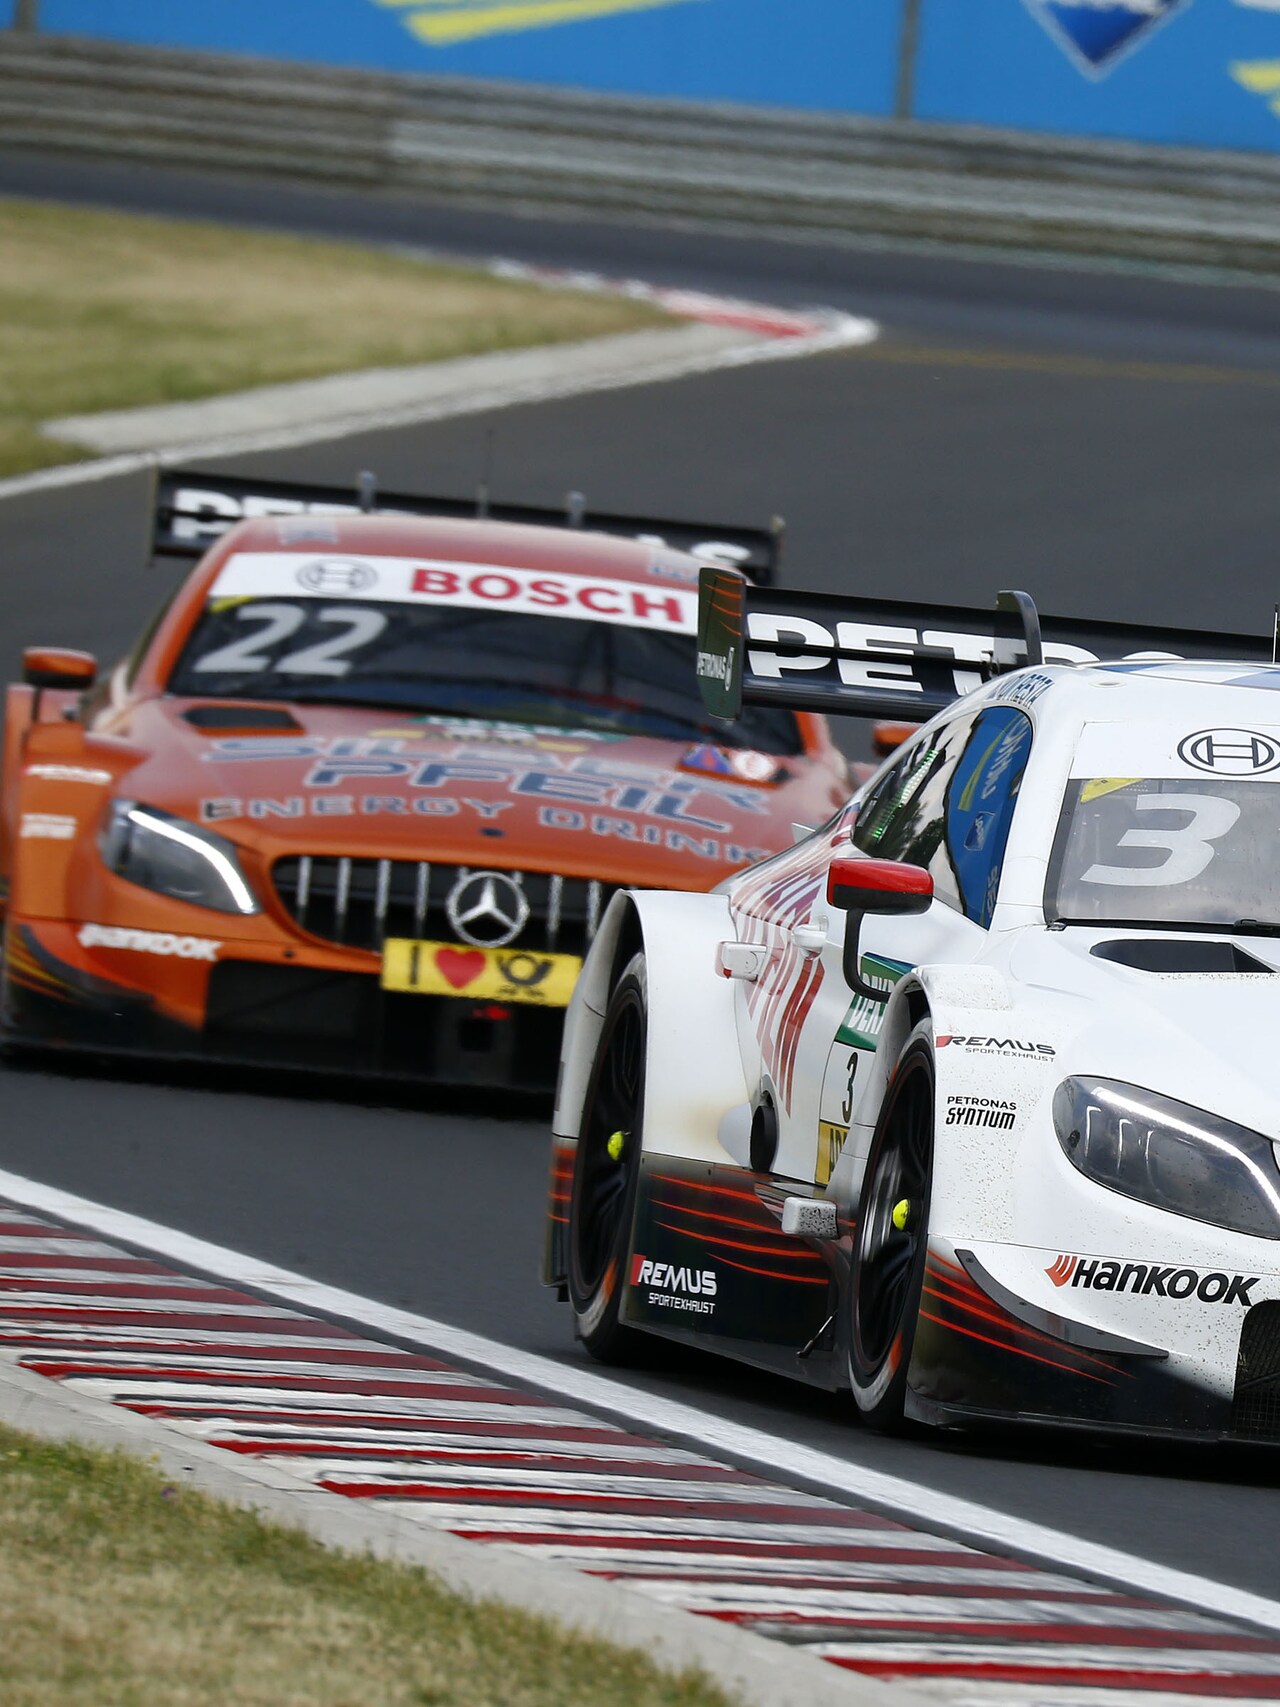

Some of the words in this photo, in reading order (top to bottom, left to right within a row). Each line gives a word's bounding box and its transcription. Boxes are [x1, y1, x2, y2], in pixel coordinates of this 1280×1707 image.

[410, 568, 685, 624] BOSCH
[193, 602, 388, 677] 22
[303, 760, 732, 822] PFEIL
[200, 795, 513, 822] ENERGY
[1079, 793, 1241, 887] 3
[946, 1036, 1056, 1056] REMUS
[965, 1047, 1055, 1062] SPORTEXHAUST
[842, 1051, 858, 1123] 3
[945, 1107, 1016, 1130] SYNTIUM
[947, 1096, 1017, 1110] PETRONAS
[637, 1260, 717, 1296] REMUS
[648, 1292, 716, 1314] SPORTEXHAUST
